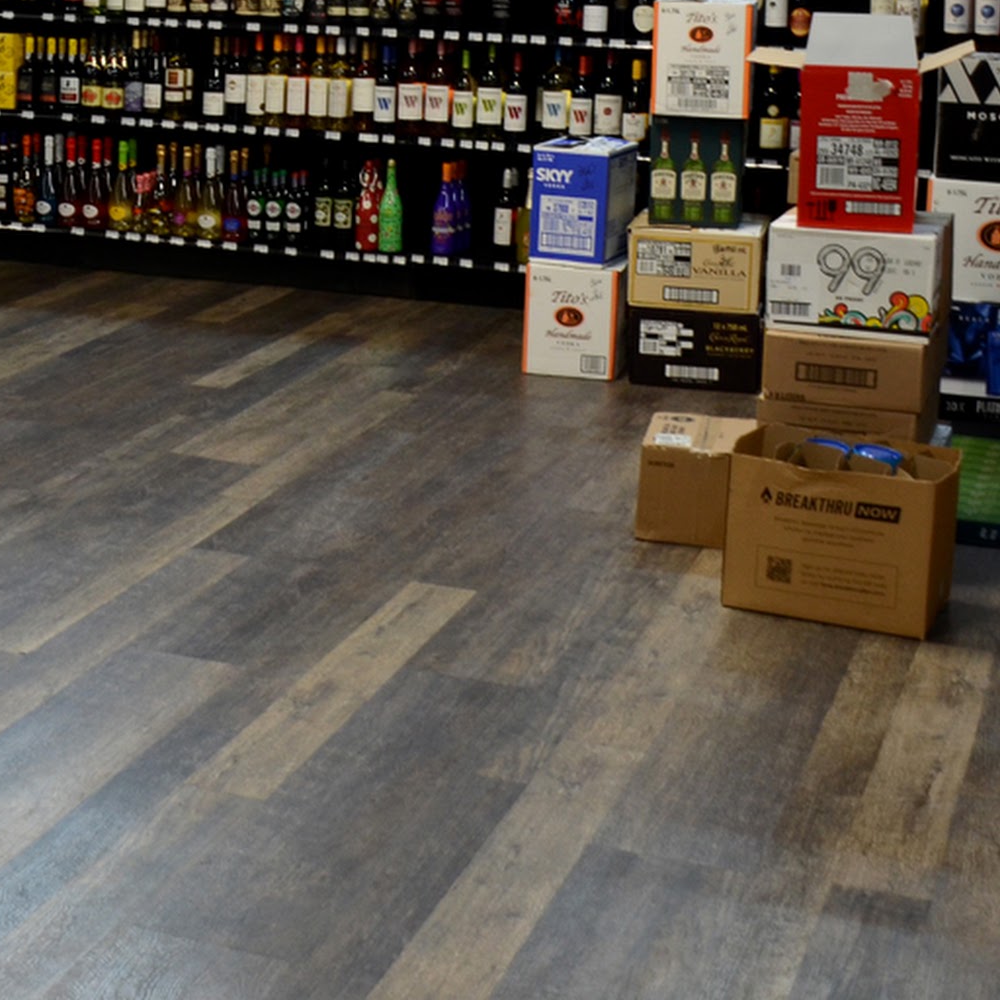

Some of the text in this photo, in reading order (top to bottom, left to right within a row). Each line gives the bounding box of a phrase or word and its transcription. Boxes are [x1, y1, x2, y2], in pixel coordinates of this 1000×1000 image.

[966, 111, 1000, 122] MOS
[536, 167, 573, 184] SKYY
[692, 267, 747, 278] VANILLA
[816, 244, 886, 297] 99
[551, 289, 589, 305] Tito's
[775, 491, 899, 520] BREAKTHRU NOW
